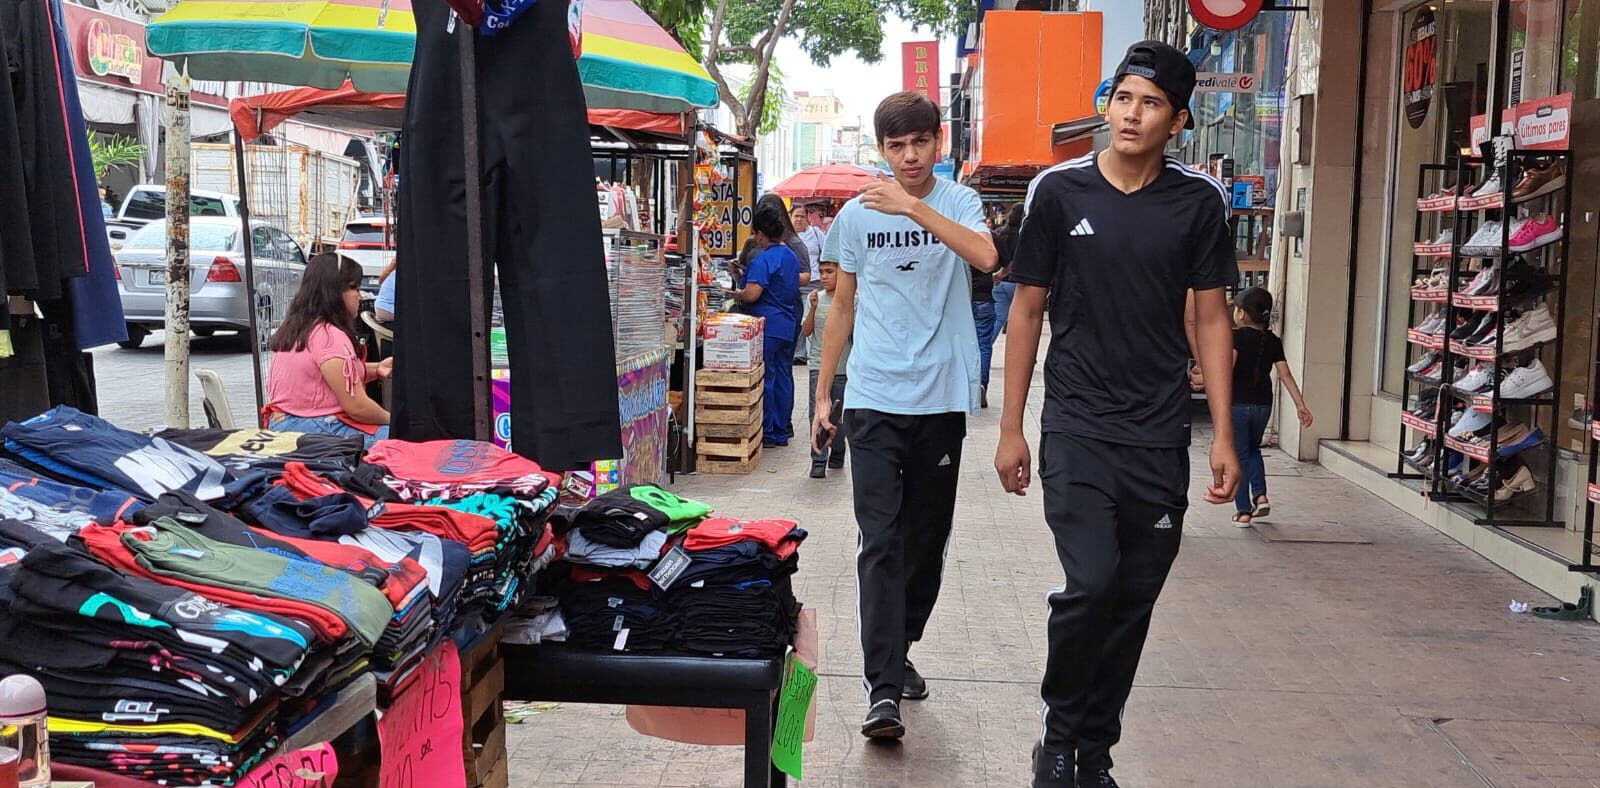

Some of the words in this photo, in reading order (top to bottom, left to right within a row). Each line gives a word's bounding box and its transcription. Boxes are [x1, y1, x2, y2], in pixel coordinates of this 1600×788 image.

[1404, 36, 1437, 92] 60%
[1521, 121, 1546, 138] últimos
[1548, 120, 1566, 139] pares
[711, 183, 742, 201] STAL
[708, 230, 733, 248] 39.9
[867, 230, 940, 248] HOLLISTE
